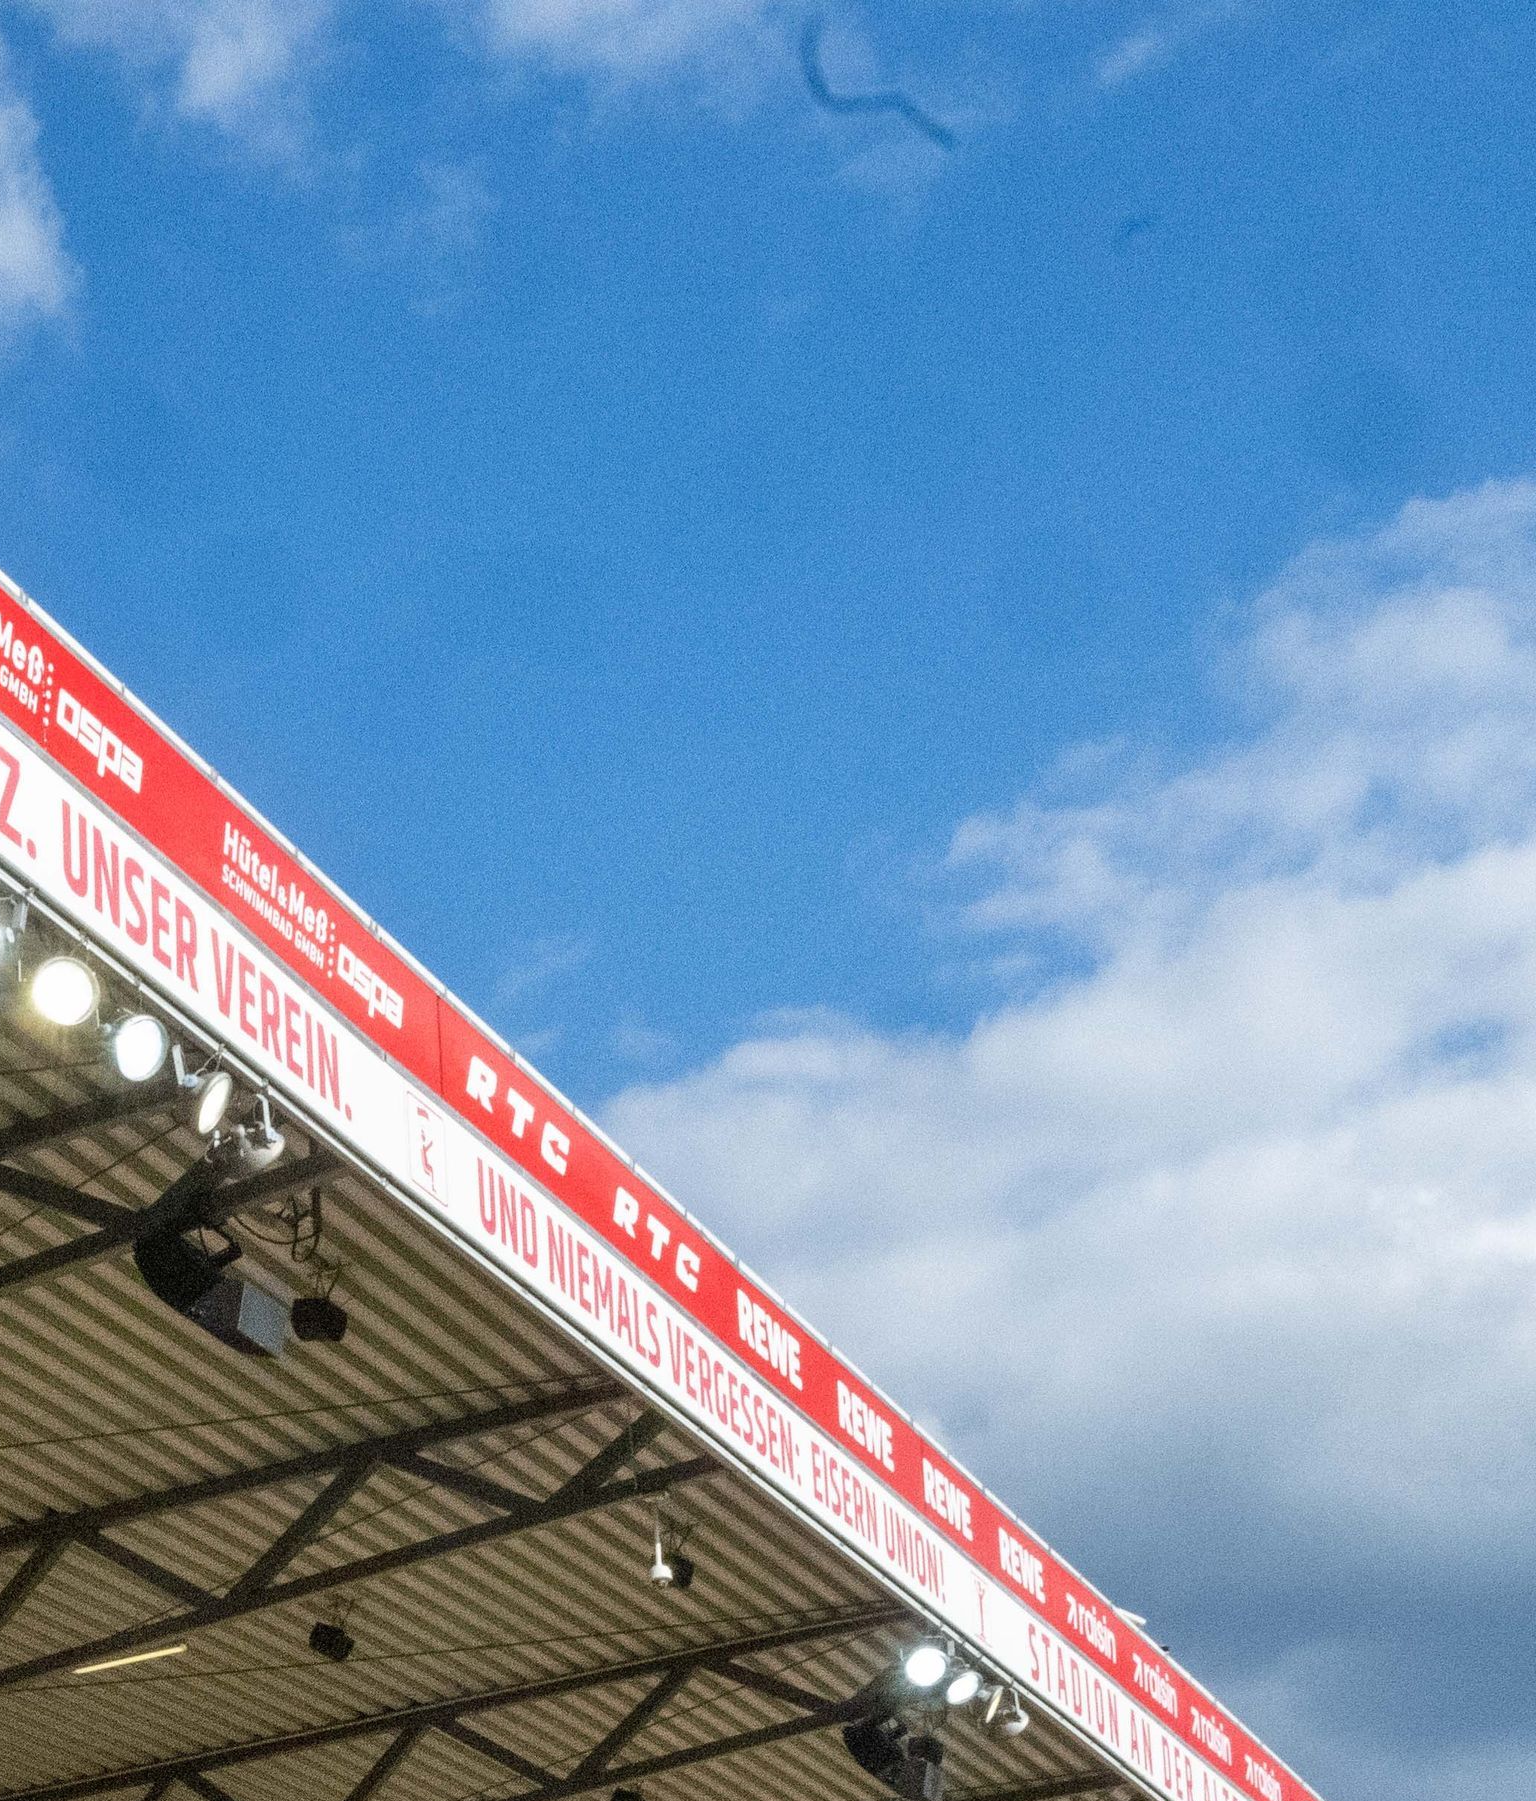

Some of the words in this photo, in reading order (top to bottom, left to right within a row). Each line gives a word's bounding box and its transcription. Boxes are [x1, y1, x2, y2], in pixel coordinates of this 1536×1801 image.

[56, 691, 144, 793] ospa
[221, 863, 294, 942] SCHWIMMBAD
[61, 798, 199, 995] UNSER
[211, 924, 353, 1122] VEREIN.
[477, 1156, 539, 1269] UND
[546, 1215, 662, 1370] NIEMALS
[665, 1314, 802, 1488] VERGESSEN:
[811, 1437, 879, 1550] EISERN
[883, 1502, 946, 1603] UNION!
[737, 1288, 803, 1392] REWE
[836, 1379, 895, 1473] REWE
[922, 1457, 973, 1543] REWE
[997, 1526, 1046, 1604] REWE
[1028, 1622, 1120, 1748] STADION
[1130, 1708, 1154, 1776] AN
